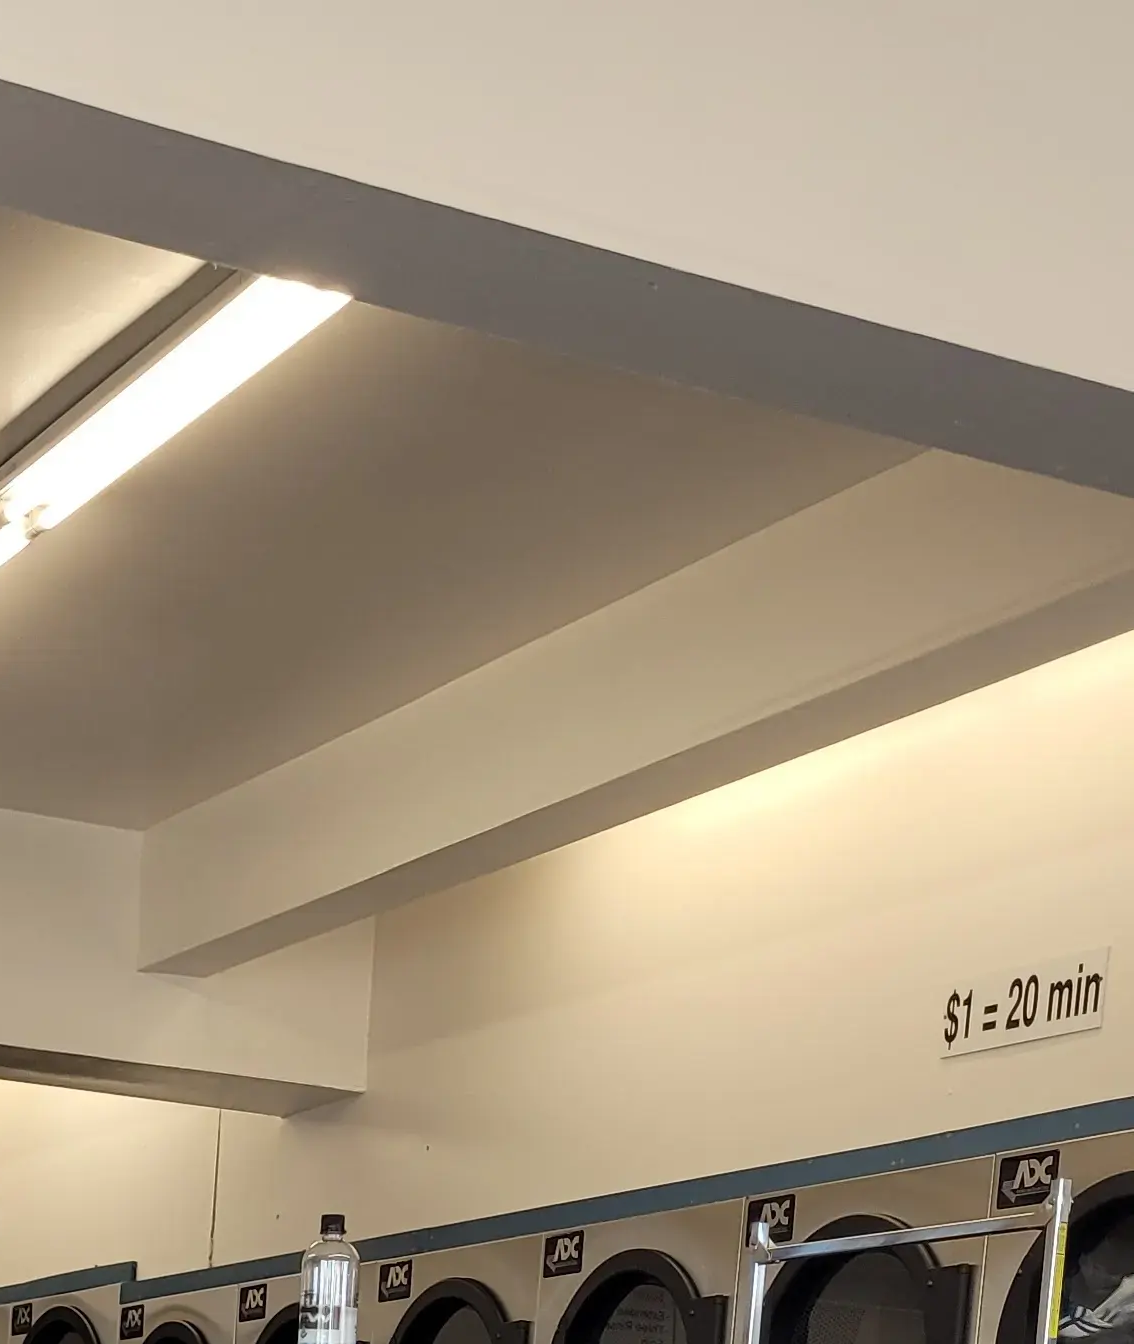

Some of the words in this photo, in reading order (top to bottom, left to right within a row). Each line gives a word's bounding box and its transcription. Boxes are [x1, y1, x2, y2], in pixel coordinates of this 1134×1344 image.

[944, 989, 973, 1051] $1
[1005, 974, 1040, 1030] 20
[1046, 963, 1102, 1022] min
[1013, 1155, 1054, 1189] ADC
[759, 1199, 791, 1228] ADC
[552, 1235, 580, 1263] ADC
[385, 1263, 409, 1289] ADC
[245, 1287, 265, 1310] ADC
